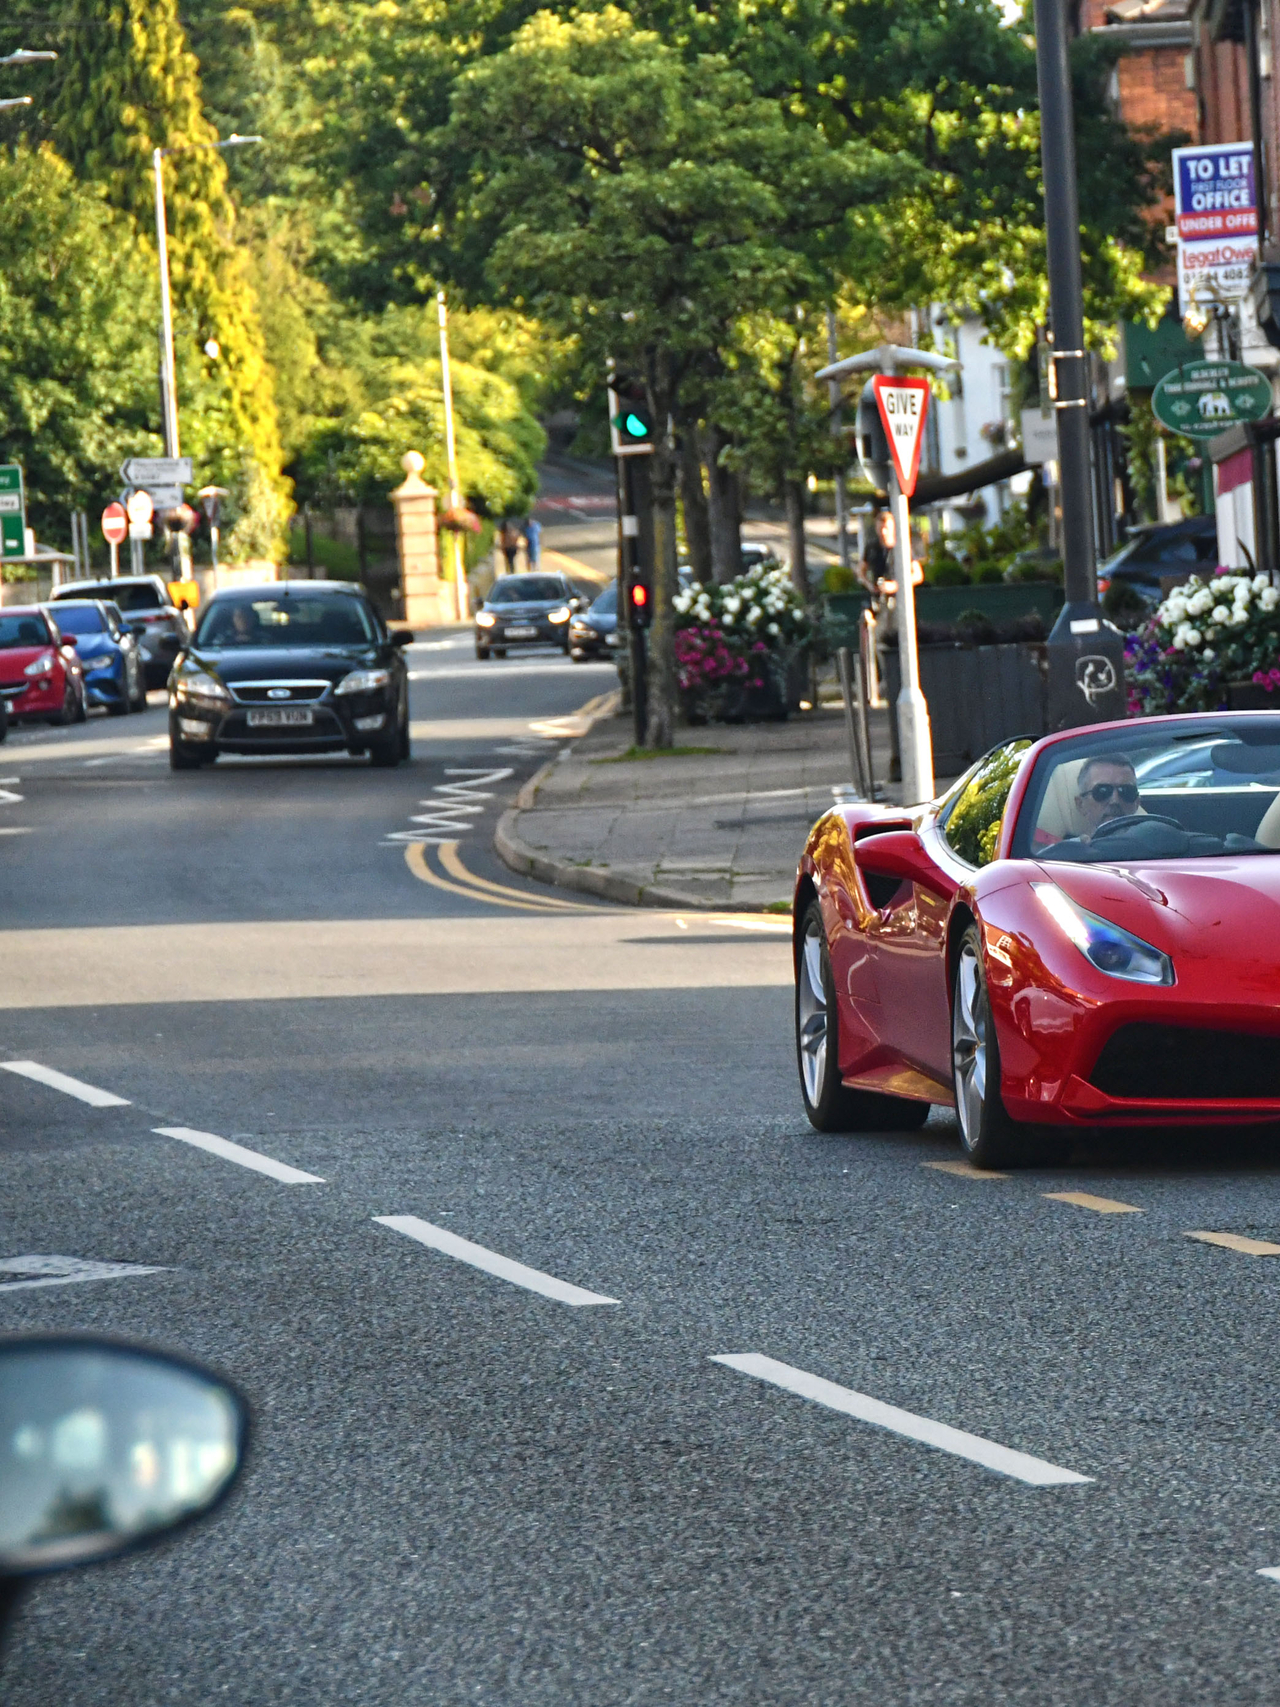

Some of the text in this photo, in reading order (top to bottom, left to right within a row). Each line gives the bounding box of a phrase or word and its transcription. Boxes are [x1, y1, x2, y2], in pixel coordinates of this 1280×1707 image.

[1186, 155, 1251, 180] TO LET
[1216, 178, 1247, 190] FLOOR
[1191, 189, 1250, 211] OFFICE
[1180, 213, 1257, 232] UNDER OFFE
[887, 392, 917, 415] GIVE
[895, 423, 914, 436] WAY
